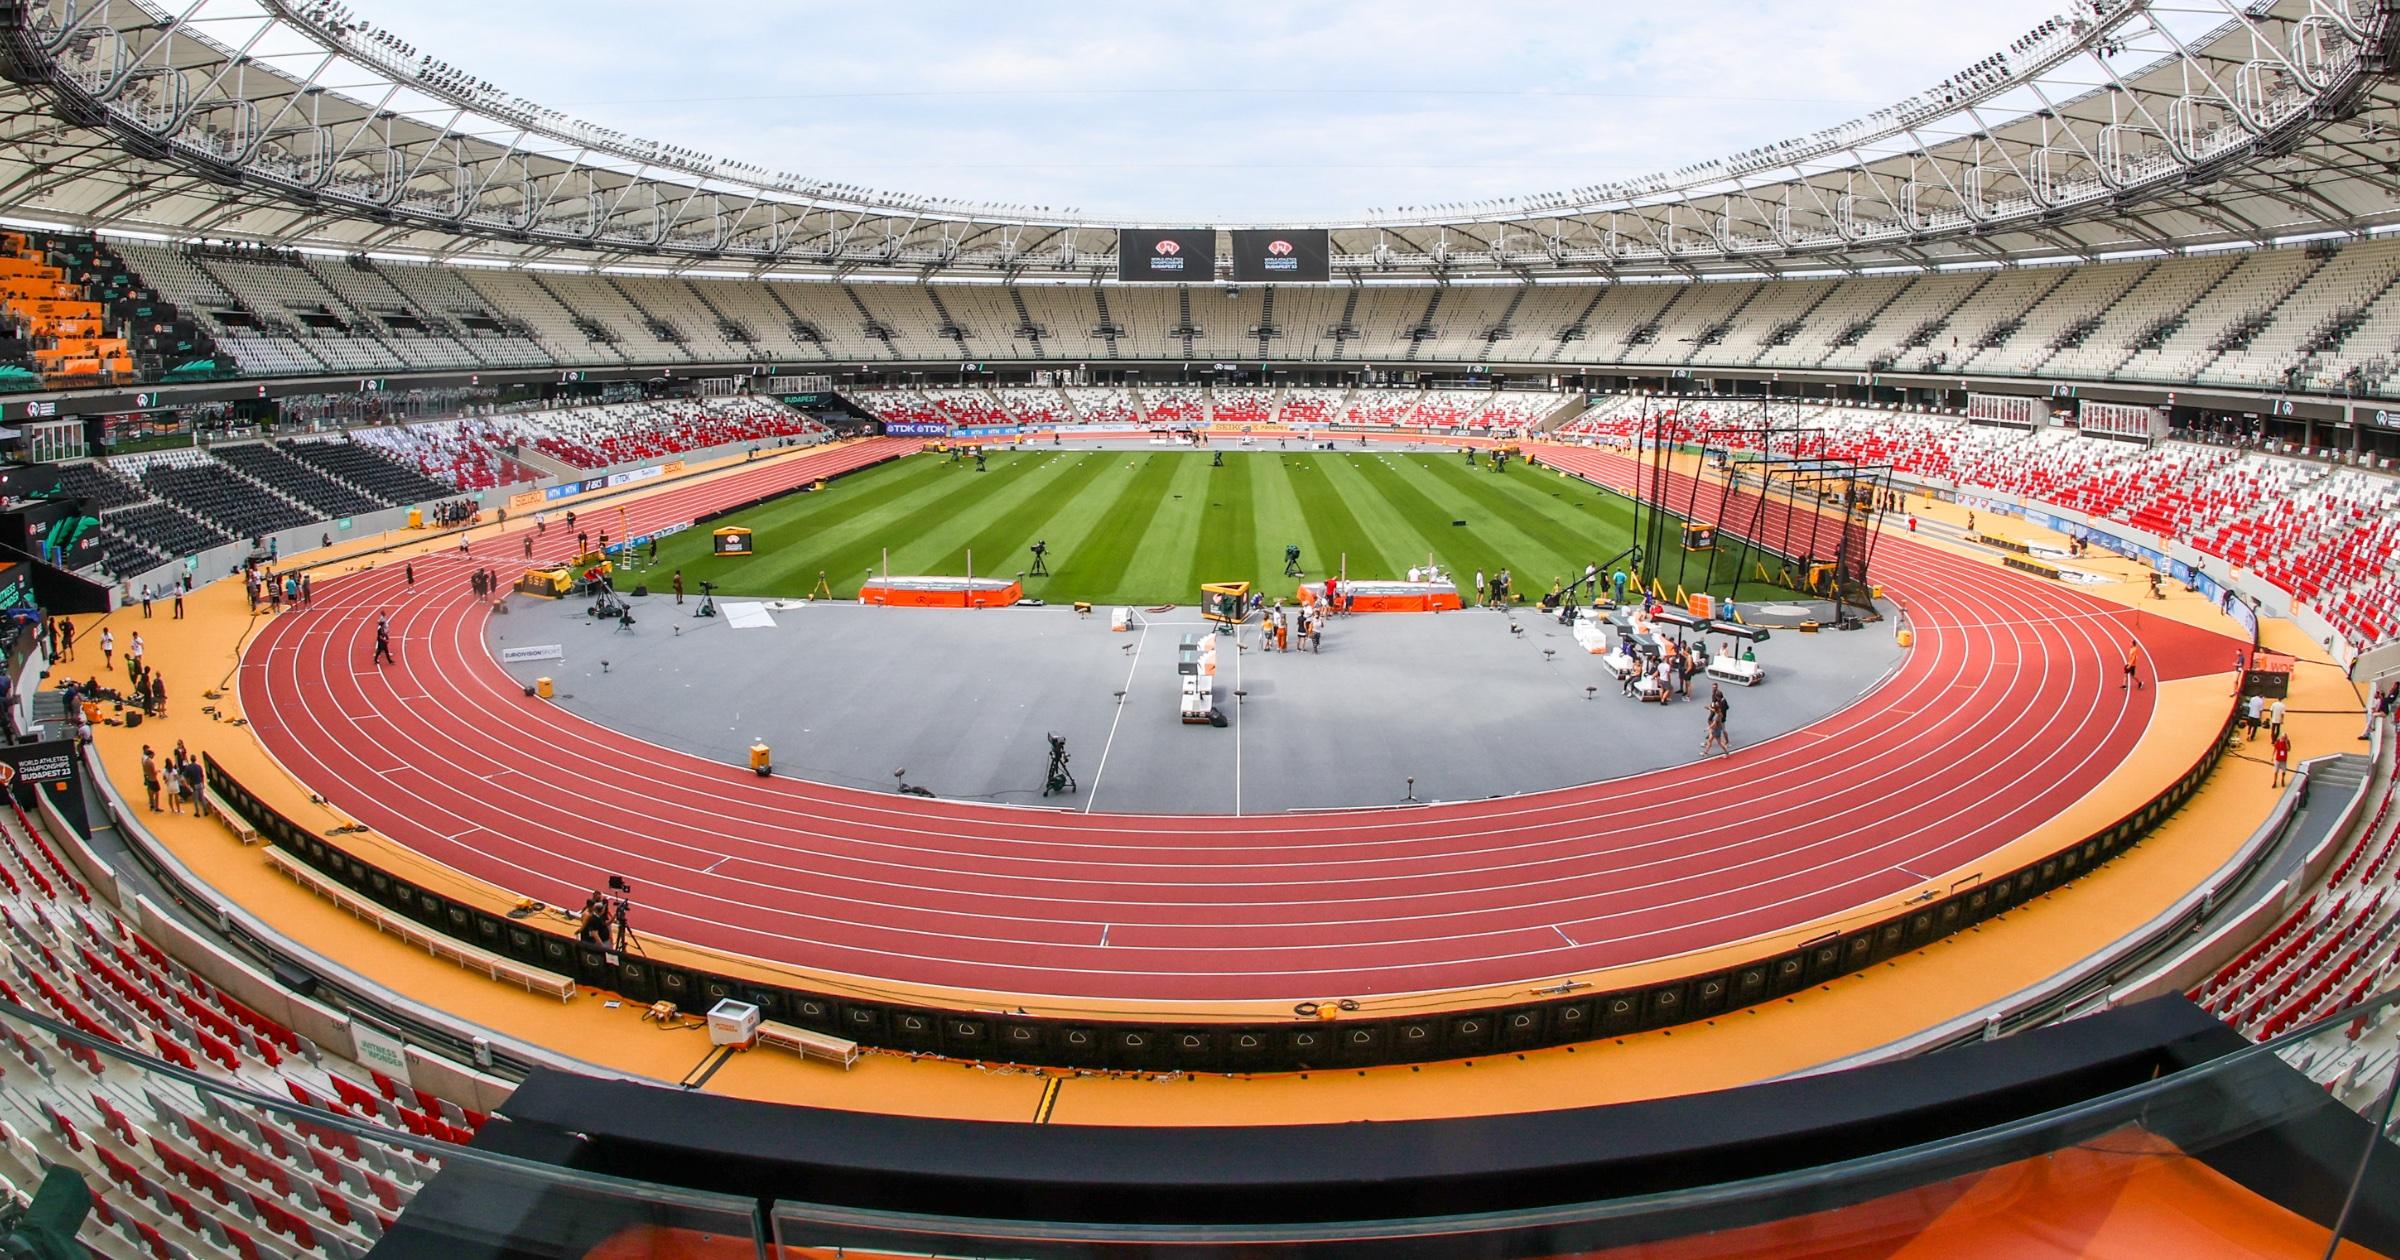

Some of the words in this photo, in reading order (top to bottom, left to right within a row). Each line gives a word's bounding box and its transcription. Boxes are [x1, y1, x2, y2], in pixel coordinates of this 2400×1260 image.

[784, 395, 818, 404] BUDAPEST
[893, 425, 915, 433] TDK
[923, 425, 945, 433] TDK
[18, 759, 38, 768] WORLD
[40, 755, 69, 764] ATHLETICS
[19, 761, 70, 774] CHAMPIONSHIPS
[21, 769, 61, 781] BUDAPEST
[361, 1040, 397, 1058] WITNESS
[368, 1050, 404, 1068] WONDER
